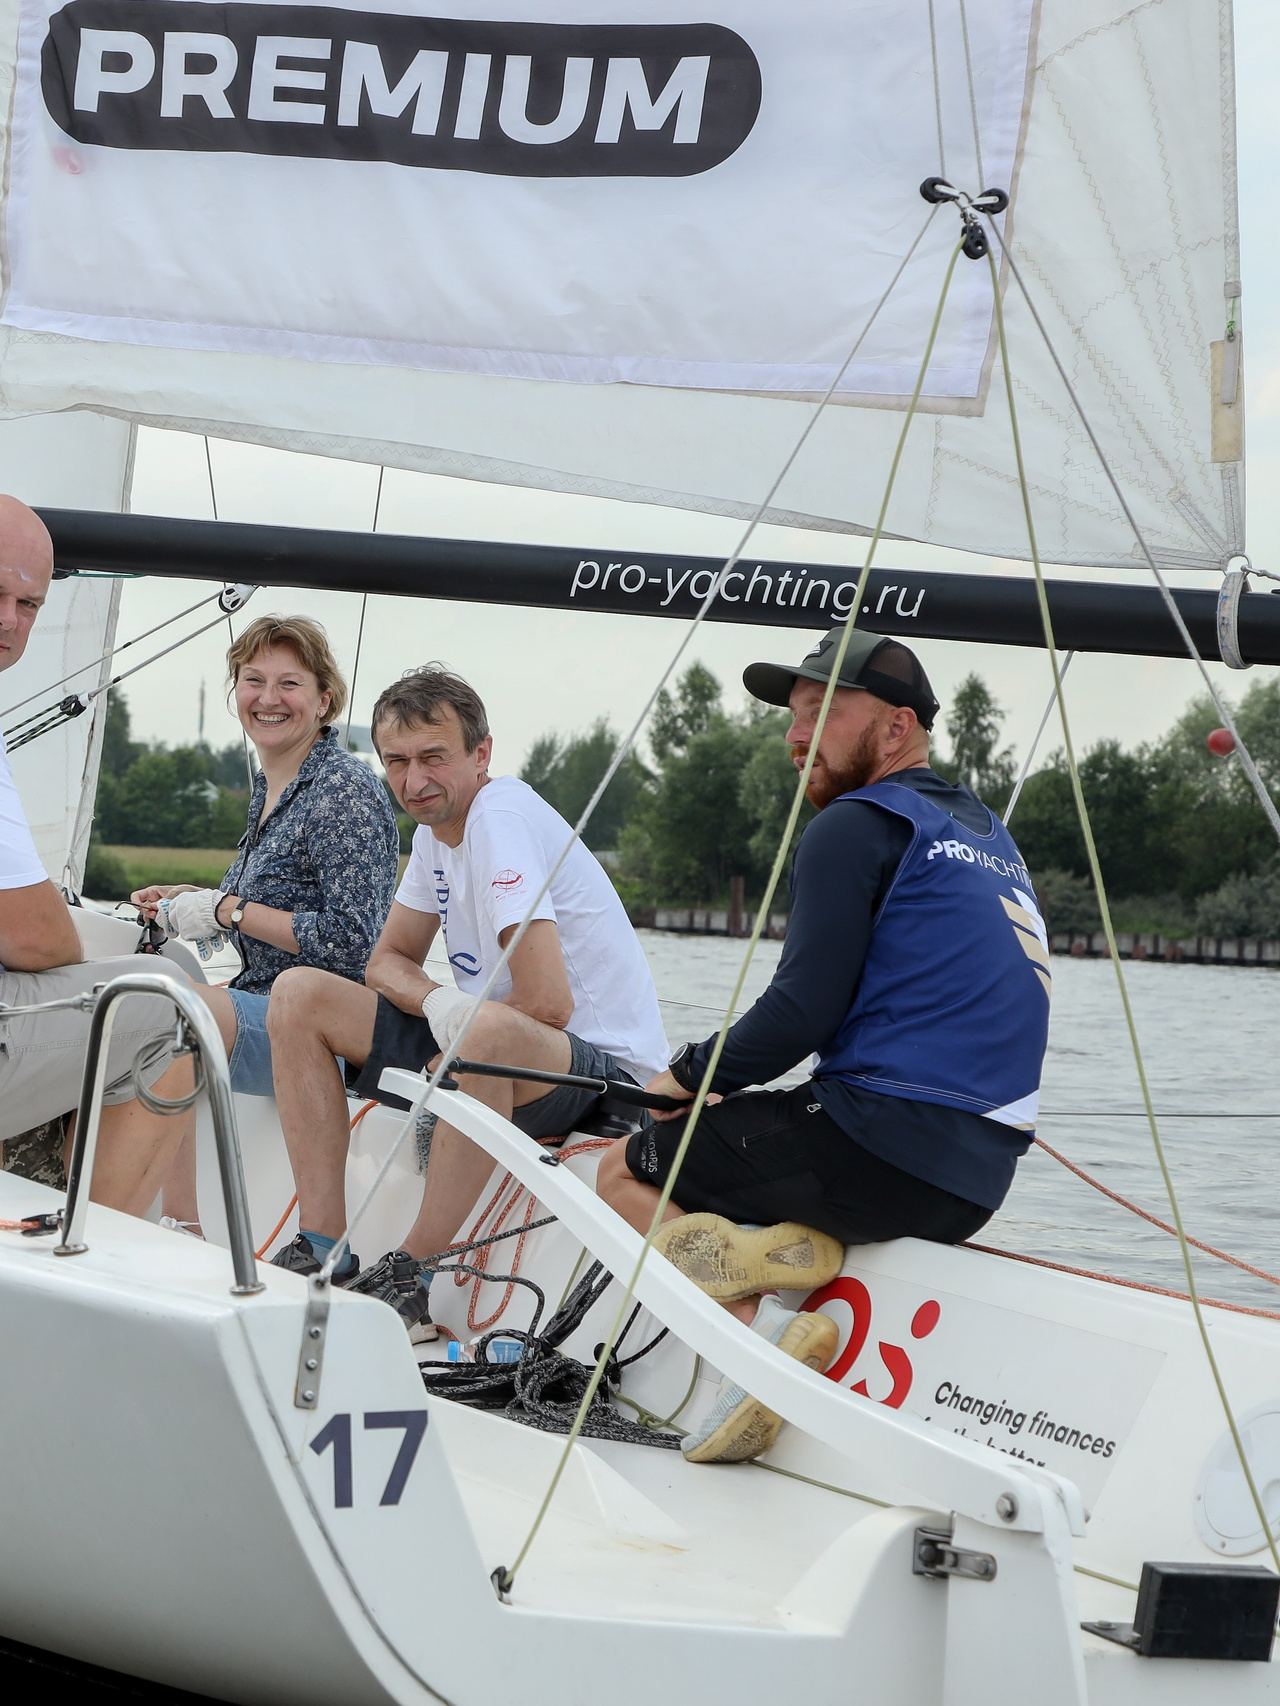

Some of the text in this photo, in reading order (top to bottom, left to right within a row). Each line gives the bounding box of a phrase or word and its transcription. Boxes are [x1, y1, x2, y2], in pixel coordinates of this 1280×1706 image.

[73, 27, 712, 145] PREMIUM
[569, 559, 926, 621] pro-yachting.ru
[309, 1410, 429, 1509] 17
[934, 1381, 1117, 1459] Changing finances
